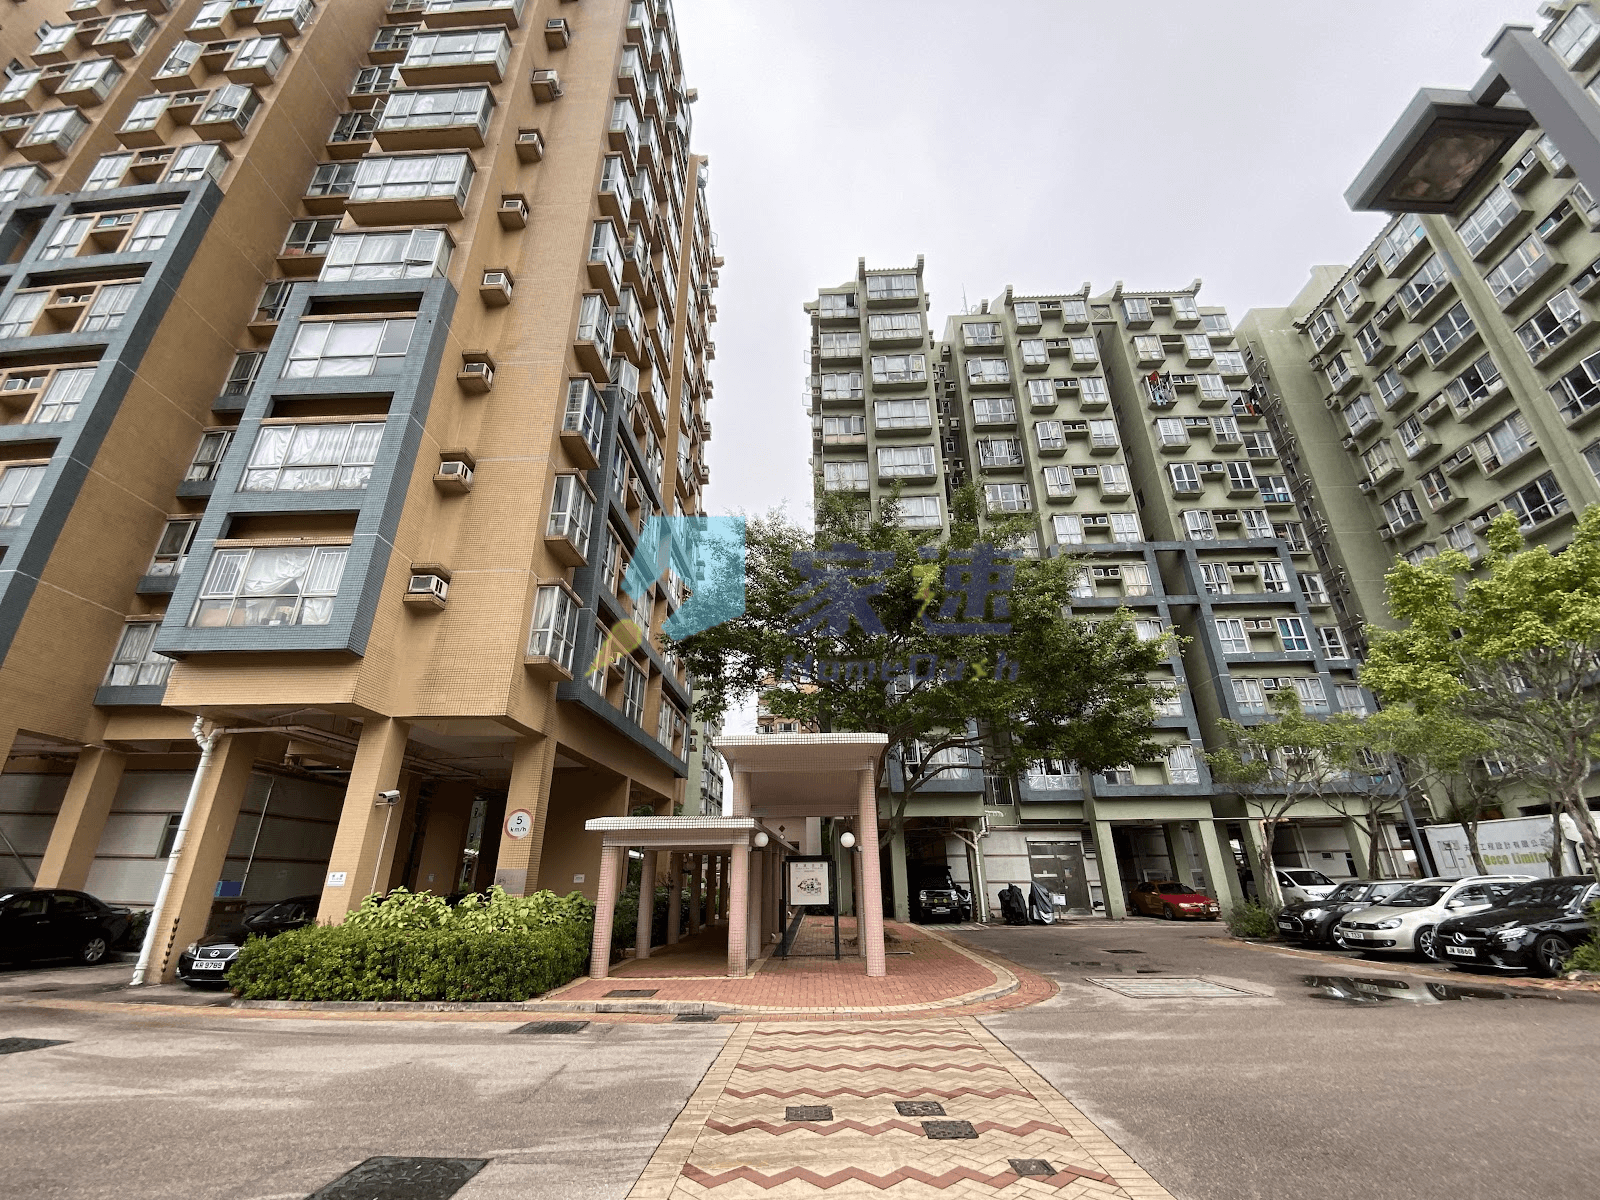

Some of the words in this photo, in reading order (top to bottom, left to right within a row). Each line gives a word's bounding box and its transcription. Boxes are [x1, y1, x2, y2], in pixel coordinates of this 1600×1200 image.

[516, 815, 523, 825] 5
[1464, 838, 1548, 852] 天工程設計有限公司
